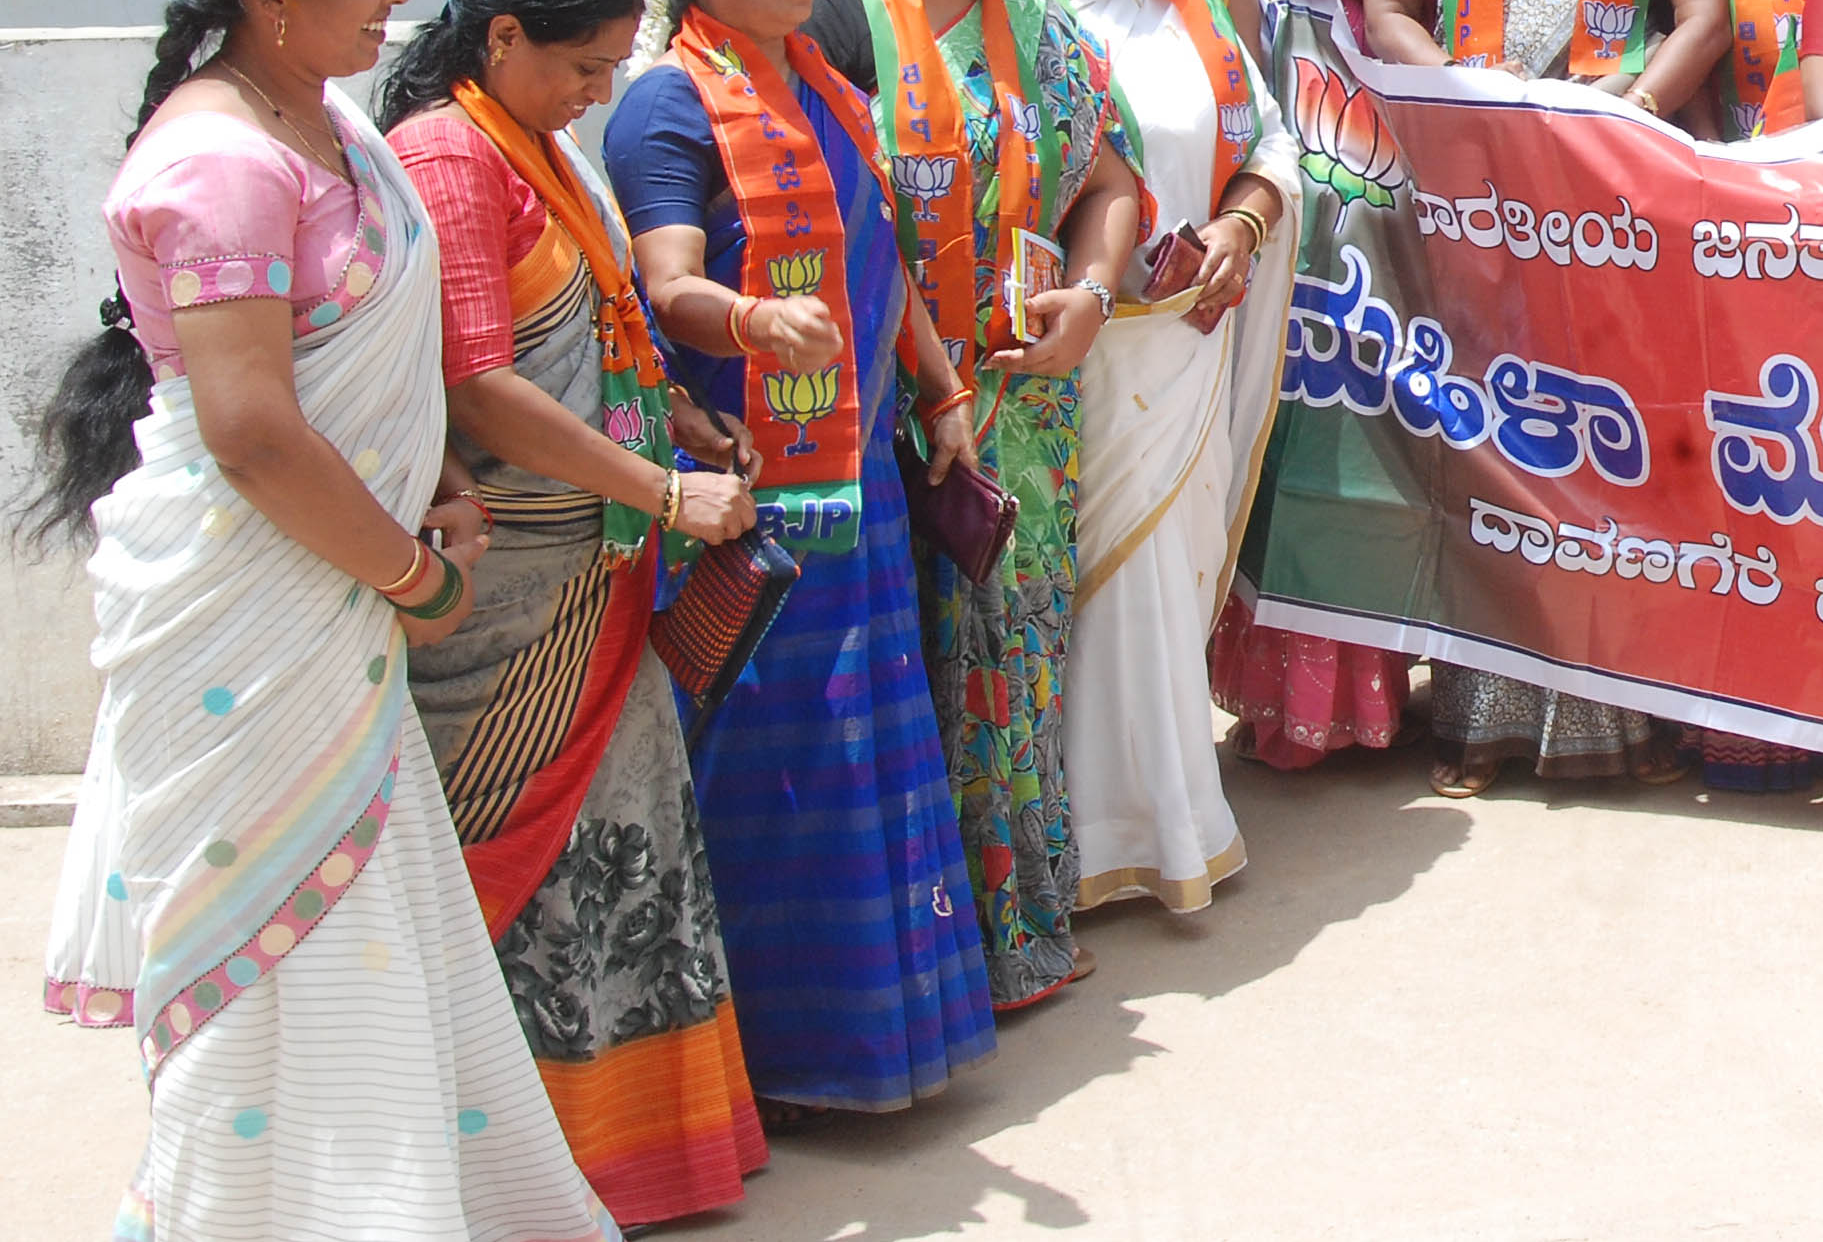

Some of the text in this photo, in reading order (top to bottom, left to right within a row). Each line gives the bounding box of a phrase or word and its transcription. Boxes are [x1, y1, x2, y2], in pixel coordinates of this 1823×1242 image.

[1279, 244, 1651, 487] ಮಹಿಳಾ
[756, 499, 853, 541] BJP
[1468, 496, 1785, 607] ದಾವಣಗೆರೆ
